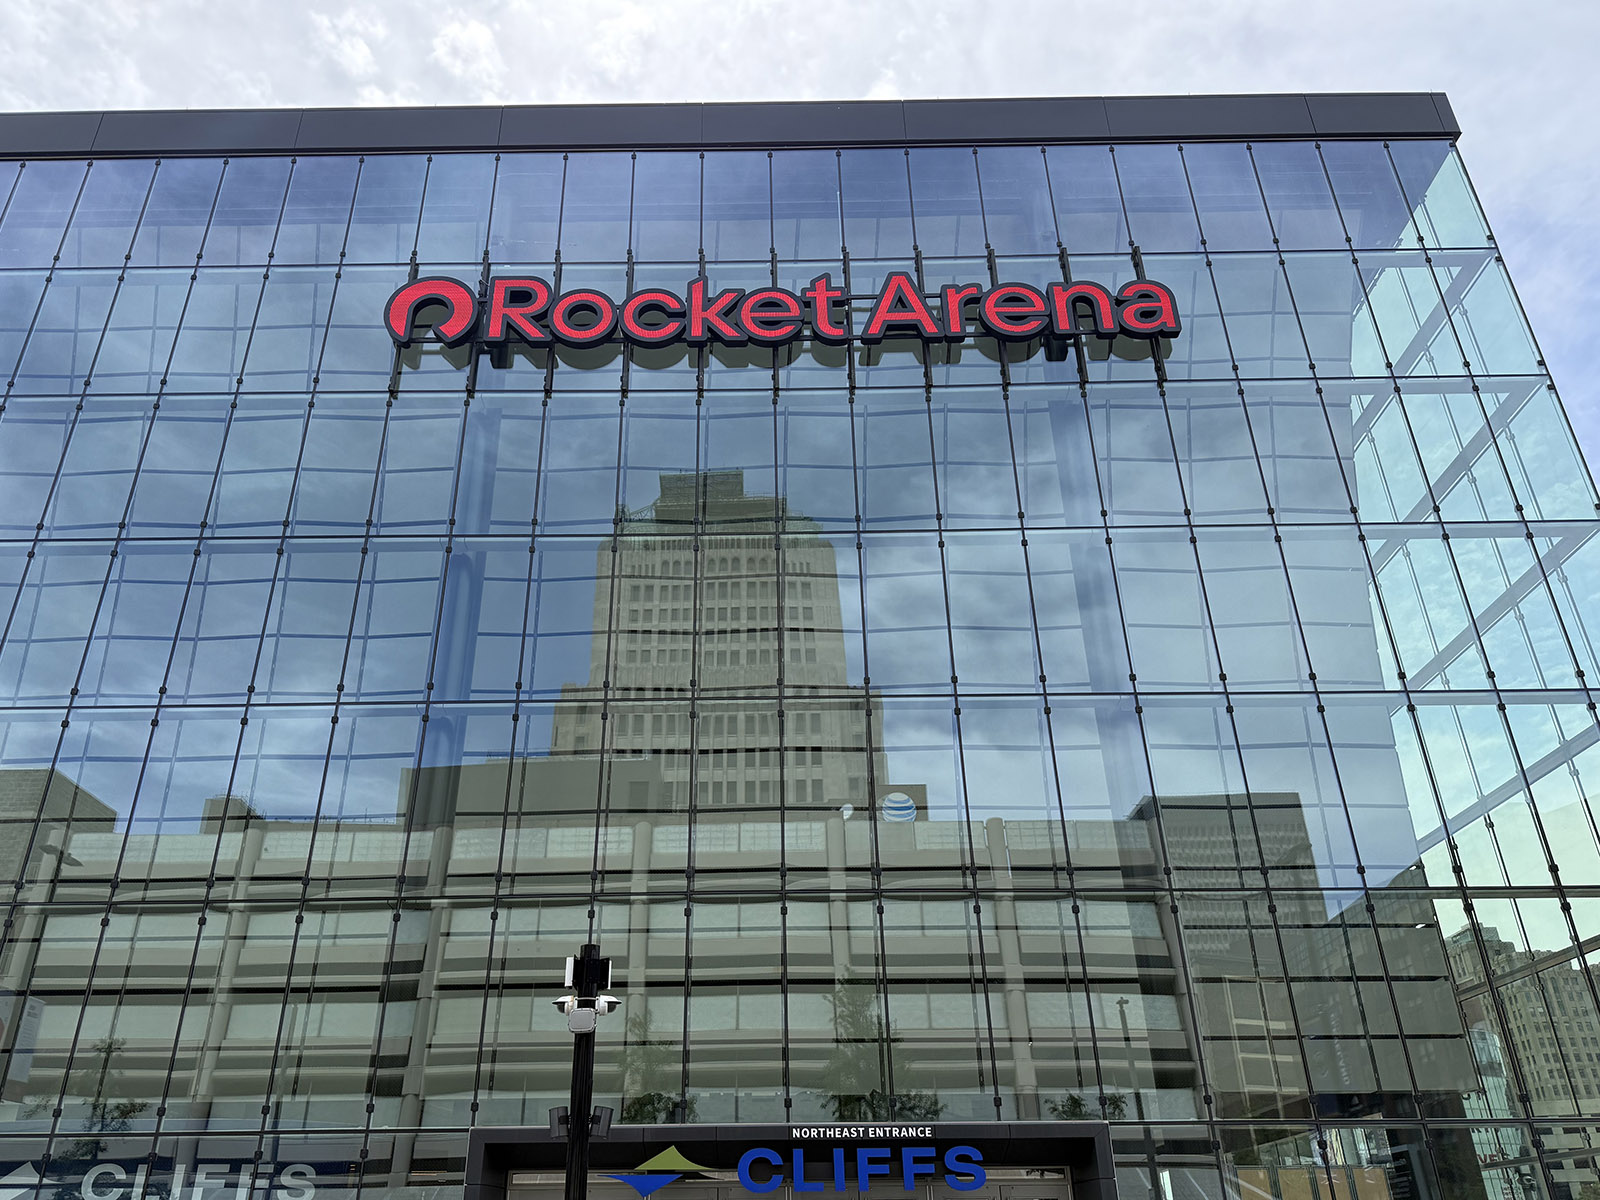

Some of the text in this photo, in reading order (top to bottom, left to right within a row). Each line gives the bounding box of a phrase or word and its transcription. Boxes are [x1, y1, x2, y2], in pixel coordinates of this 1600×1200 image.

[485, 272, 1180, 342] Rocket Arena
[792, 1126, 933, 1138] NORTHEAST ENTRANCE
[81, 1163, 316, 1200] CLIFFS
[737, 1146, 987, 1193] CLIFFS
